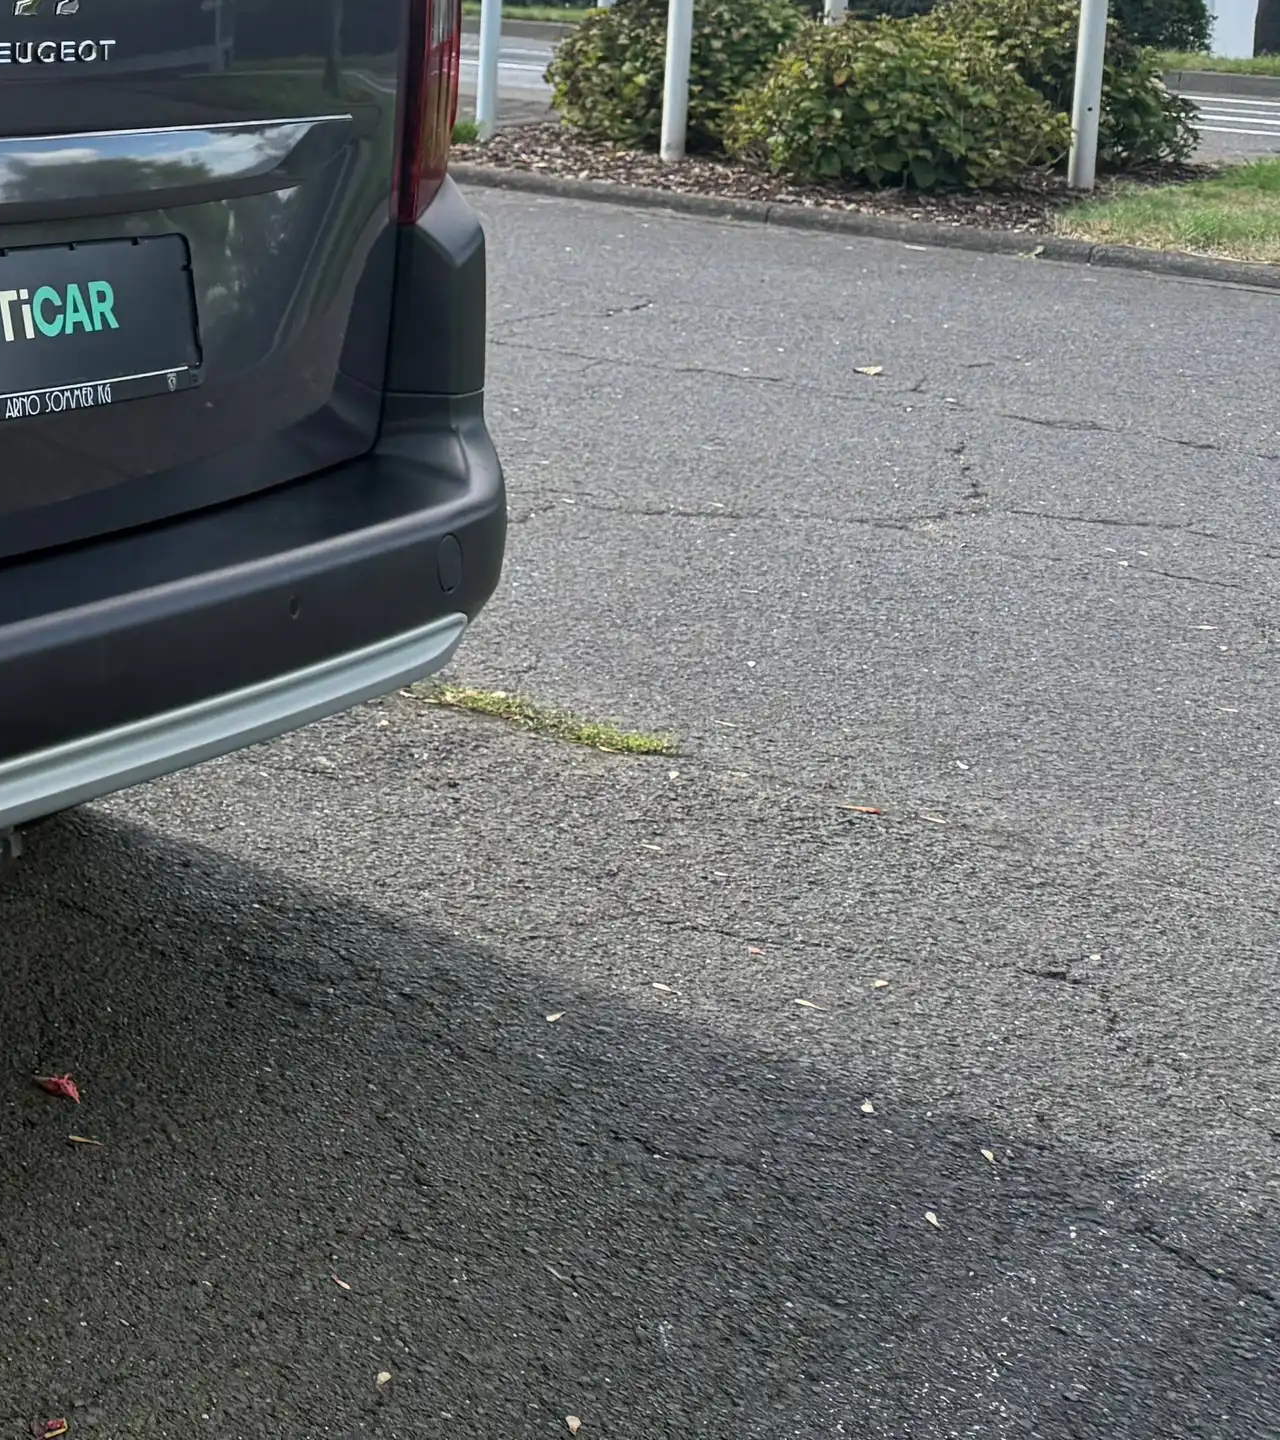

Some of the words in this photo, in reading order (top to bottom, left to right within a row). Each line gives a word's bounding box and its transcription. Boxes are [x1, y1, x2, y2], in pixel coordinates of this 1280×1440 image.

[5, 391, 41, 418] ARNO
[44, 386, 95, 415] SOMMER
[97, 383, 113, 406] KG
